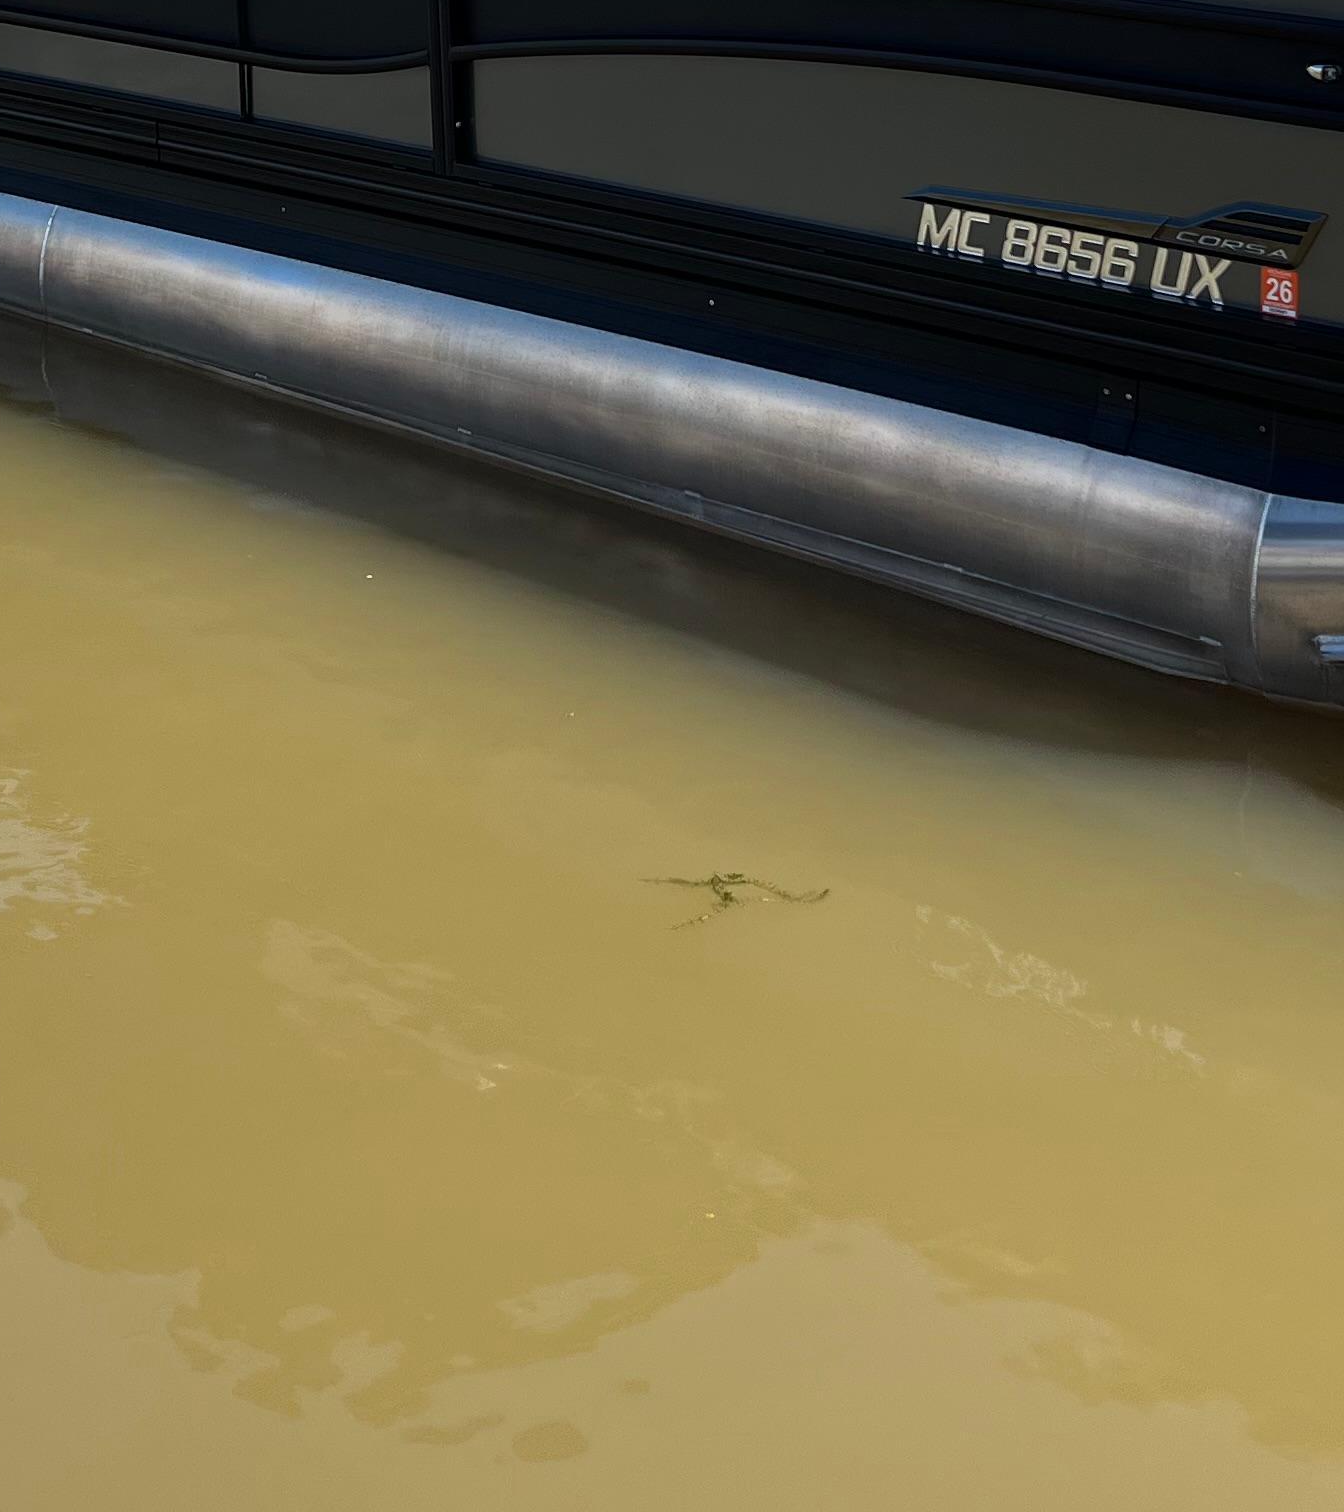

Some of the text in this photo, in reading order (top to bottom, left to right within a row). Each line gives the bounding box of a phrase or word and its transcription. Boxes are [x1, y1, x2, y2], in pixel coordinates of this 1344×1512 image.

[916, 202, 1233, 305] MC 8656 UX
[1175, 231, 1289, 260] CORSA
[1266, 277, 1294, 304] 26
